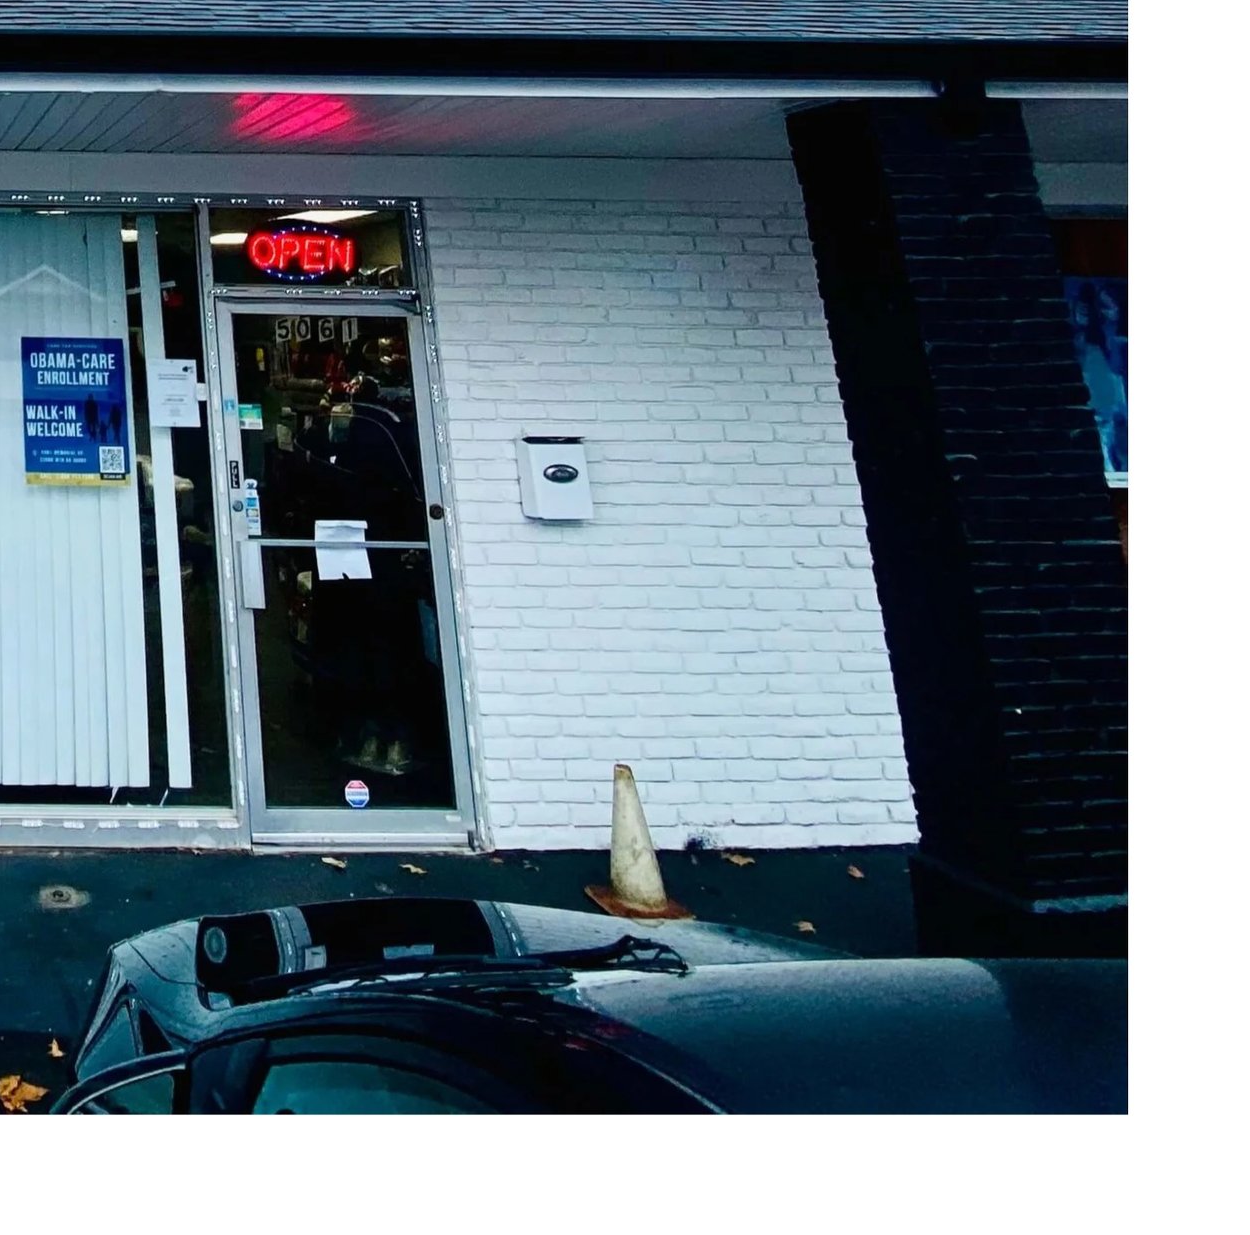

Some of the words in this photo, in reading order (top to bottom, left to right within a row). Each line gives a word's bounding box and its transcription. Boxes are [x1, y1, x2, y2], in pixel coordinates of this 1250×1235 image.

[251, 235, 352, 272] OPEN
[276, 318, 354, 340] 5061
[30, 352, 116, 370] OBAMA-CARE
[37, 370, 110, 386] ENROLLMENT
[25, 405, 77, 420] WALK-IN
[26, 422, 84, 438] WELCOME
